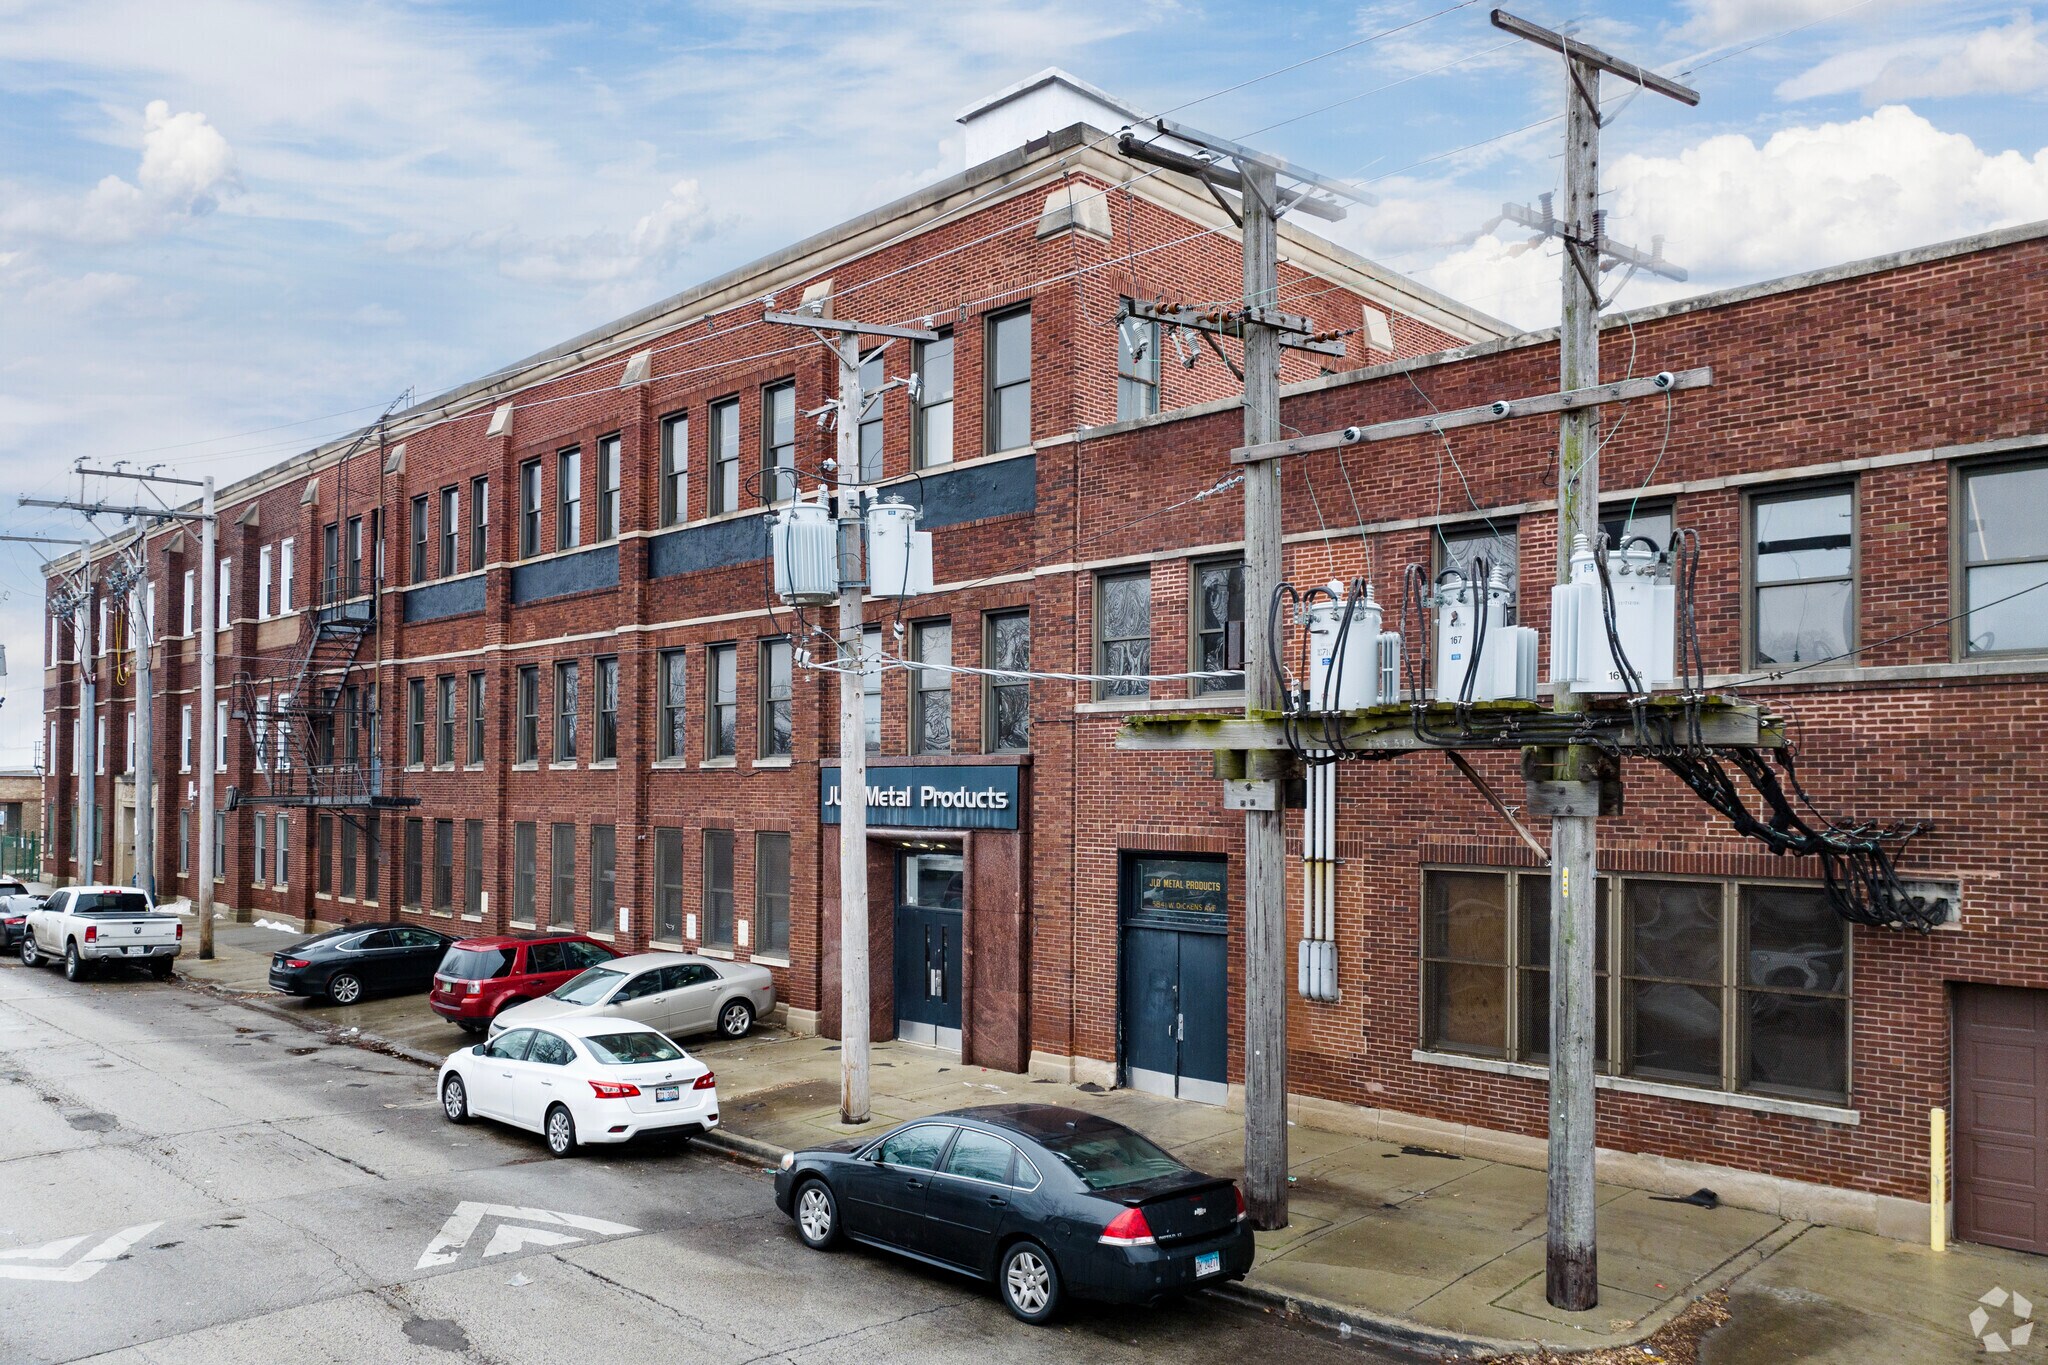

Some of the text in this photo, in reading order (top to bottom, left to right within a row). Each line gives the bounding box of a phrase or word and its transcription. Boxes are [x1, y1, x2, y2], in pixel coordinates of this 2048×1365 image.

[1450, 635, 1463, 645] 167
[1608, 671, 1622, 681] 16
[865, 785, 911, 807] Metal
[920, 785, 1009, 809] Products
[1164, 879, 1183, 889] METAL
[1186, 881, 1220, 891] PRODUCTS
[1176, 902, 1203, 911] DICKENS
